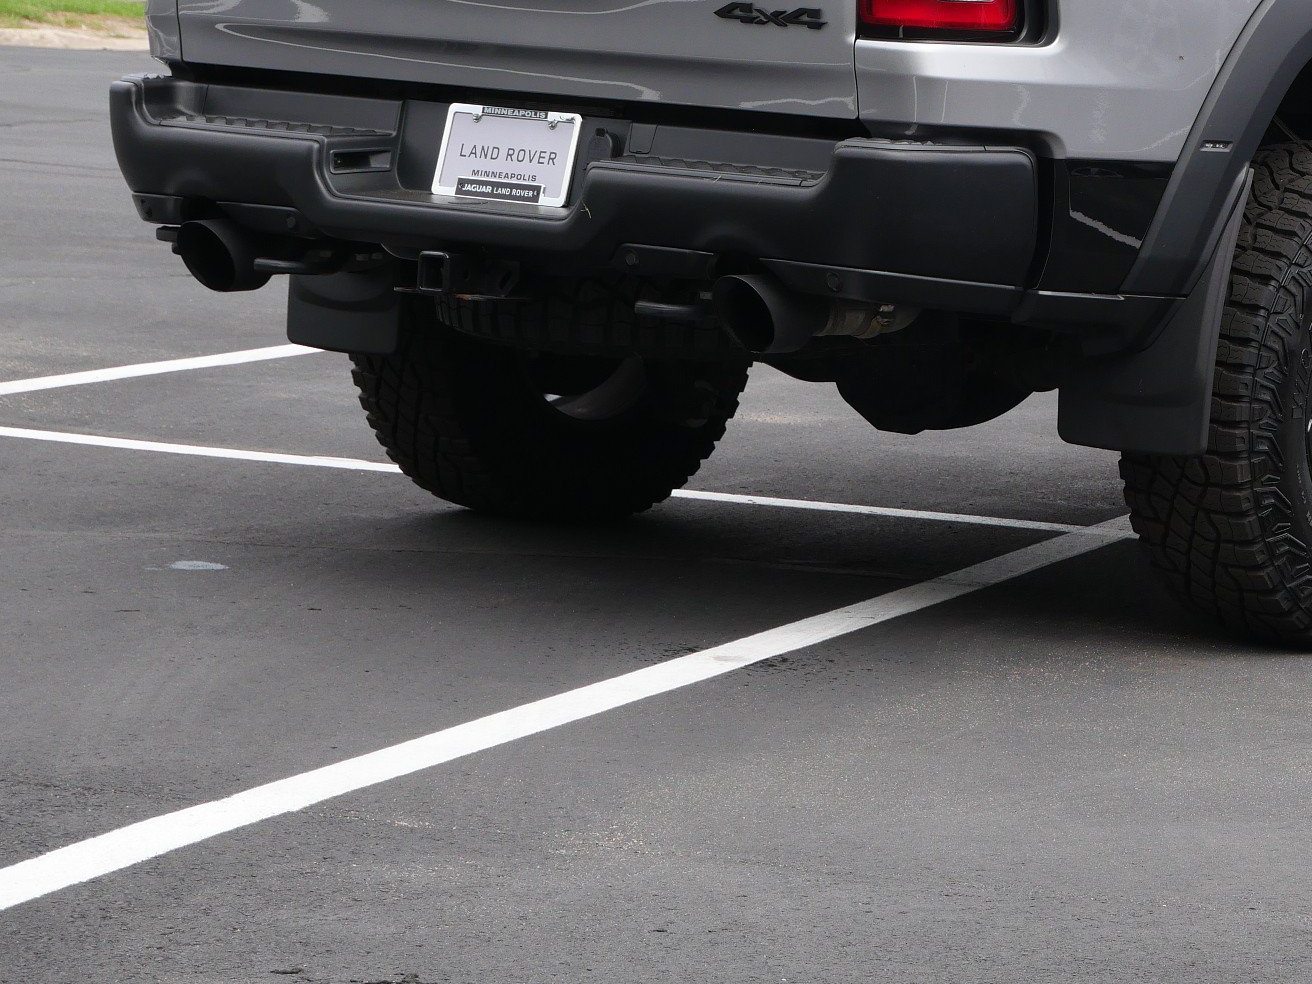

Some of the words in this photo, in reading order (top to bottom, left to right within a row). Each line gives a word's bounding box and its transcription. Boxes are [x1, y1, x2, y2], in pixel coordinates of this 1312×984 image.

[713, 2, 828, 30] 4x4
[484, 106, 546, 119] MINNEAPOLIS
[459, 143, 500, 160] LAND
[505, 148, 557, 166] ROVER
[471, 169, 537, 182] MINNEAPOLIS
[462, 183, 492, 193] JAGUAR
[493, 187, 511, 195] LAND
[511, 189, 533, 197] ROVER
